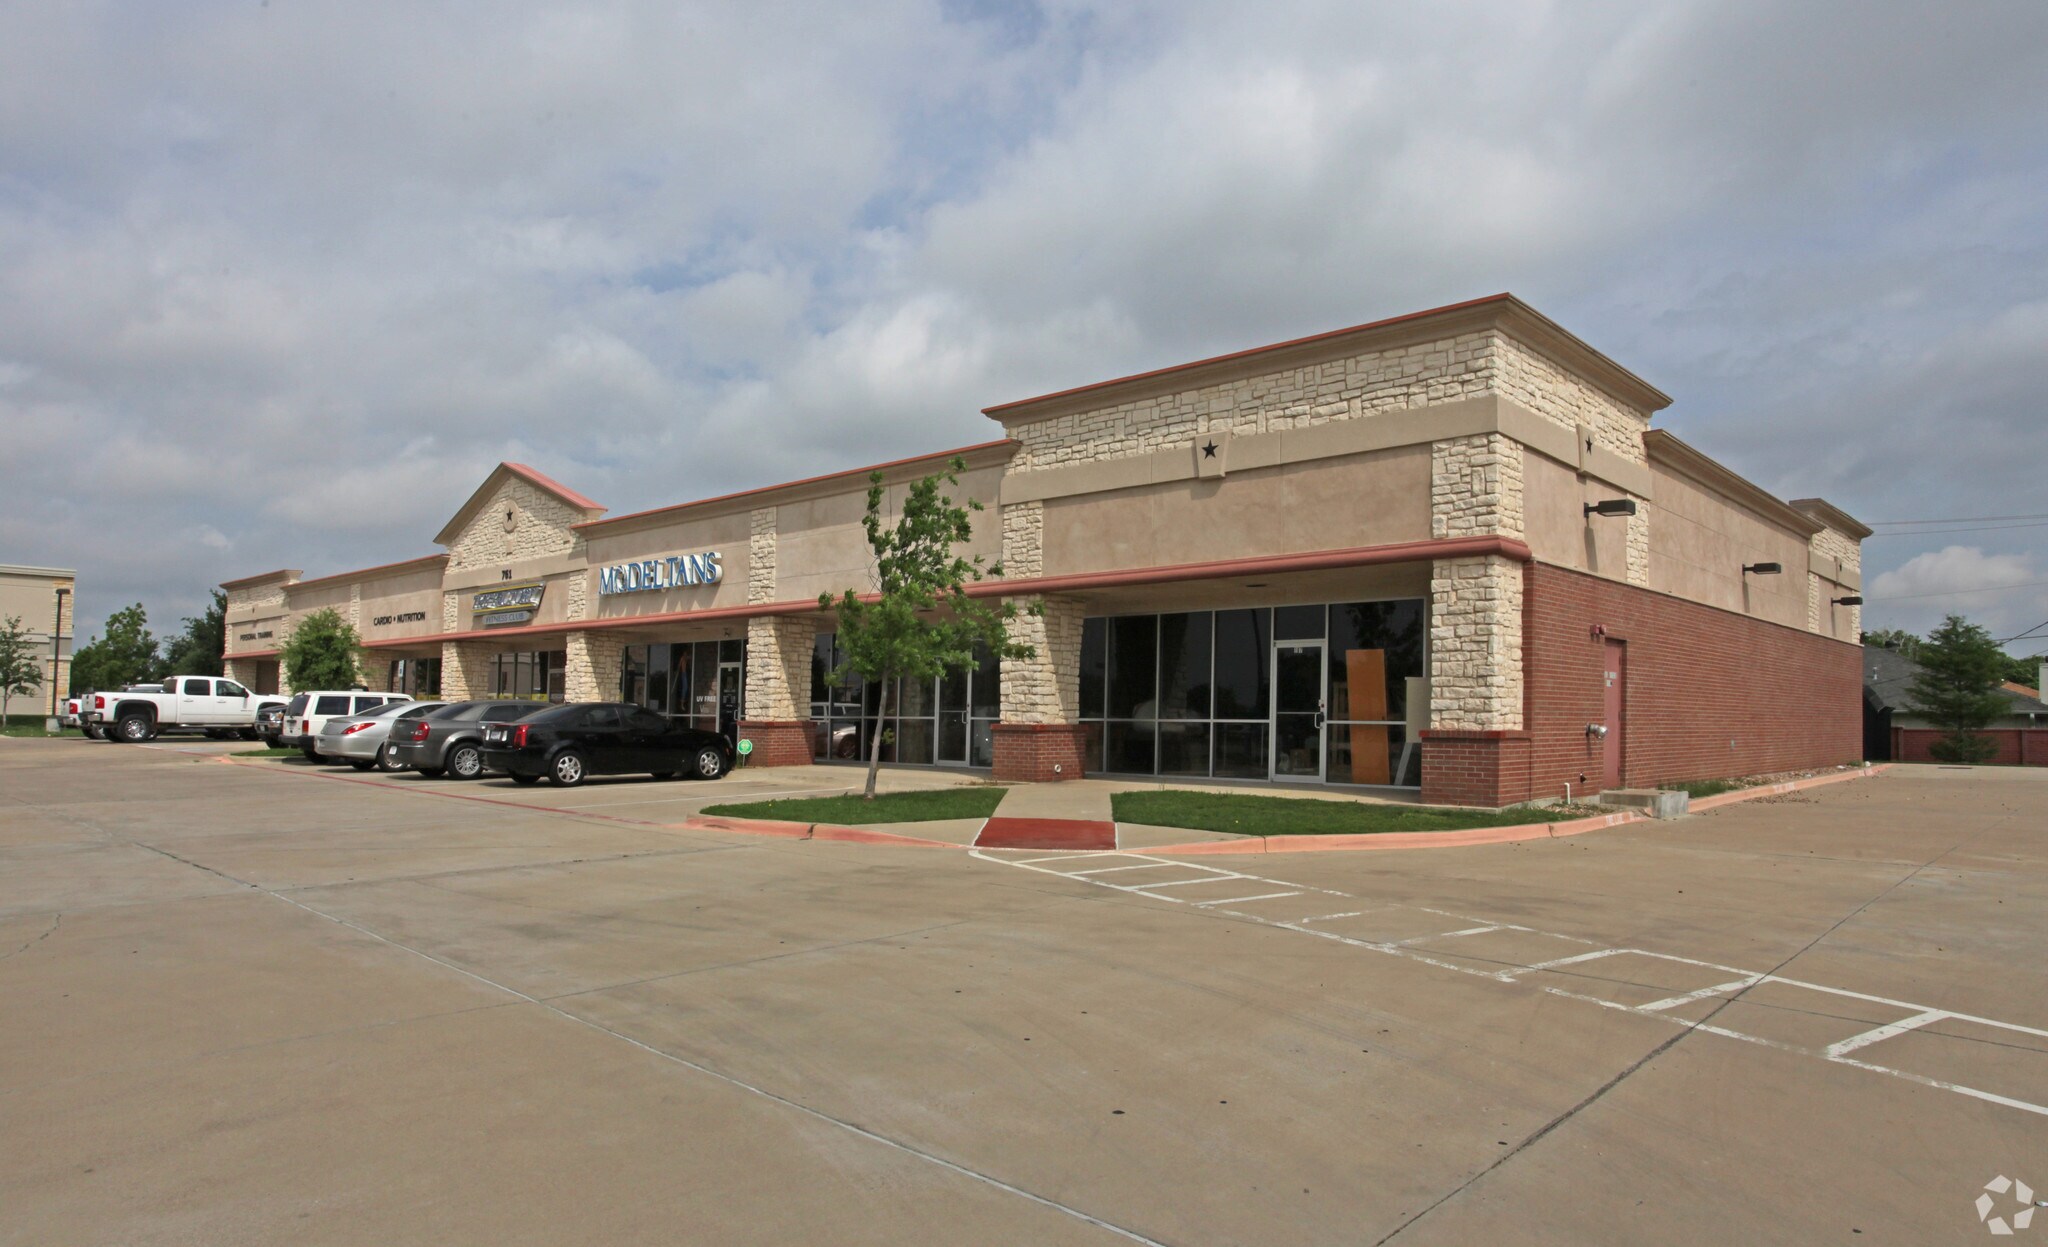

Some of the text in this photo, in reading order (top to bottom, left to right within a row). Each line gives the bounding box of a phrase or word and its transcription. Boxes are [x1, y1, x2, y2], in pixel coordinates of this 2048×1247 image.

[599, 551, 723, 595] MODEL TANS
[373, 611, 426, 626] CARDIO NUTRITION
[508, 611, 525, 621] CLUB
[240, 633, 257, 641] PERSONAL
[704, 695, 717, 703] FREE
